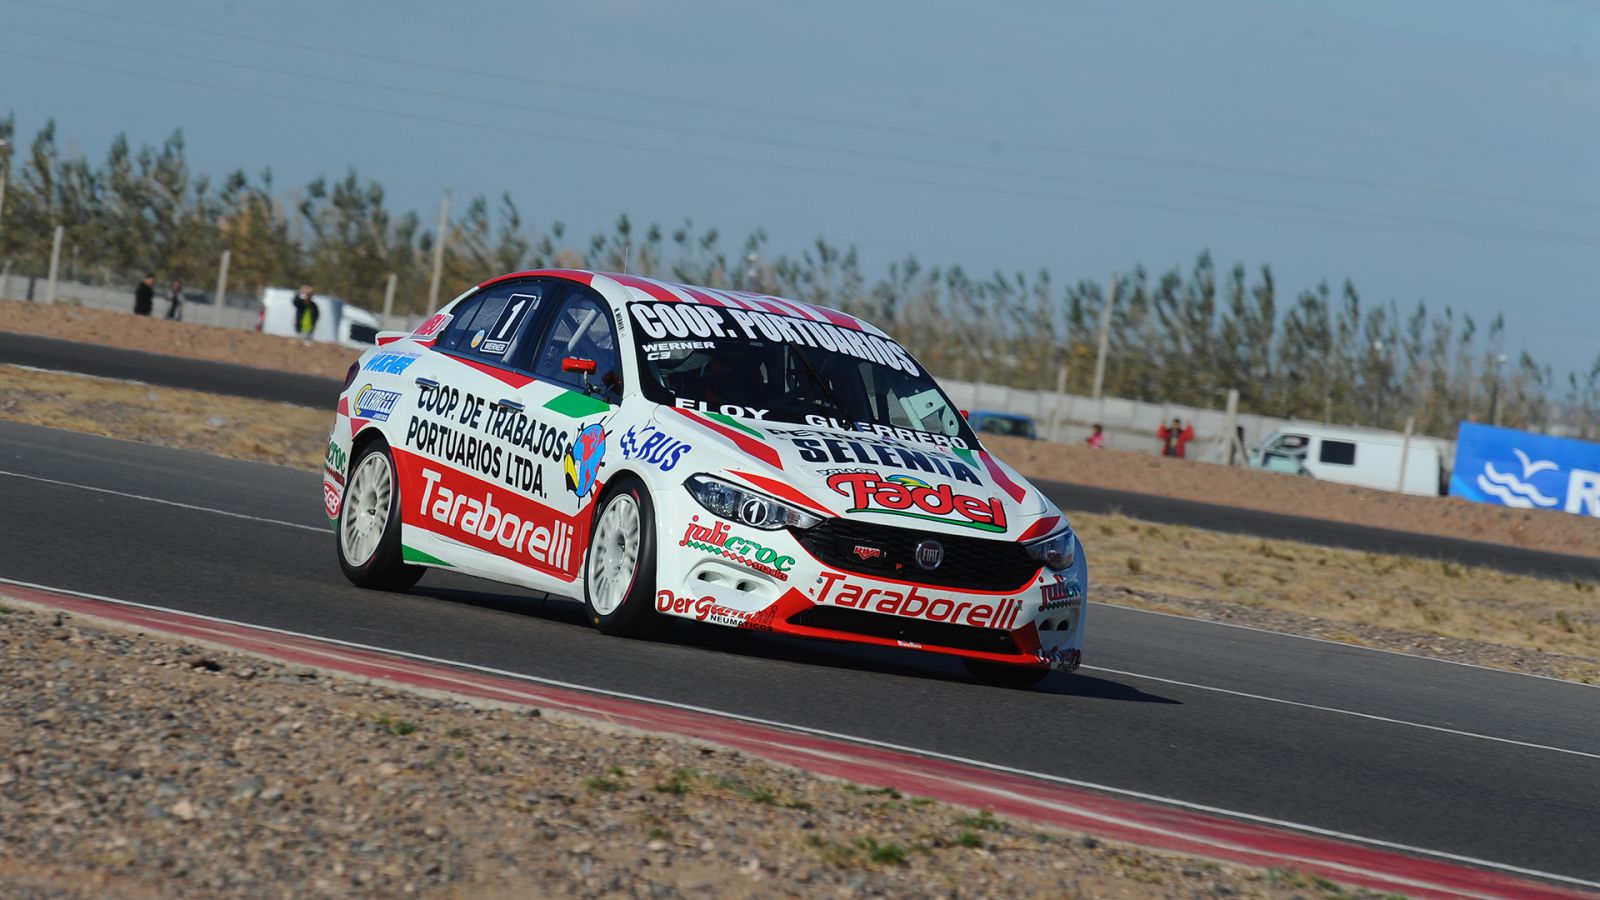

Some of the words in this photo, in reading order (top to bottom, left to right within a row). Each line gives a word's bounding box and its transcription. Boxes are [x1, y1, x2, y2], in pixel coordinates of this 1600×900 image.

[497, 299, 526, 339] 1
[630, 303, 739, 339] COOP.
[726, 308, 920, 377] PORTUARIOS
[642, 341, 716, 352] WERNER
[647, 351, 671, 361] C3
[417, 385, 460, 420] COOP.
[459, 393, 485, 430] DE
[484, 401, 568, 463] TRABAJOS
[675, 397, 769, 420] ELOY
[405, 415, 503, 479] PORTUARIOS
[505, 452, 548, 499] LTDA.
[791, 438, 983, 487] SELENIA
[419, 468, 574, 571] Taraborelli
[749, 502, 761, 523] 1
[826, 472, 1008, 529] Fadel
[752, 561, 789, 582] snacks
[922, 547, 940, 563] FIAT
[817, 571, 1020, 630] Taraborelli
